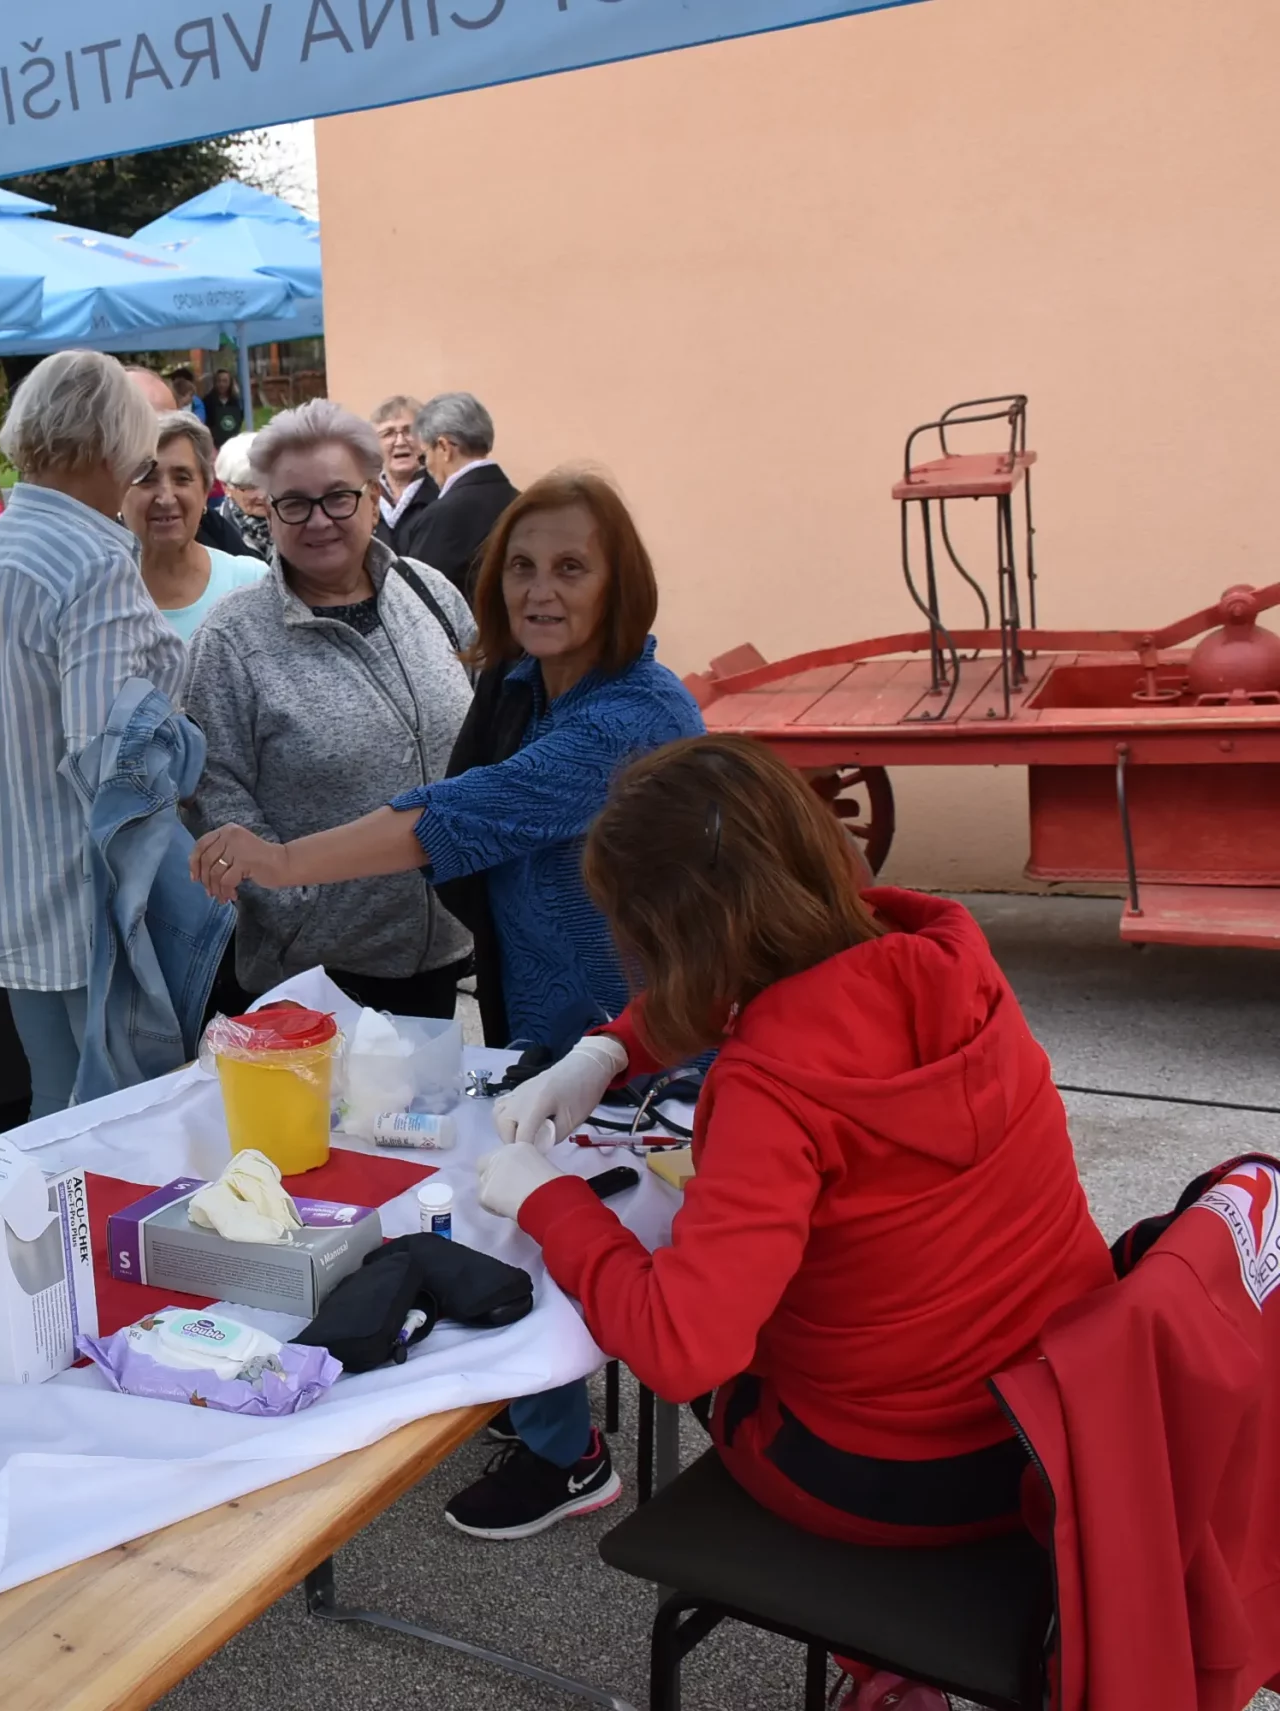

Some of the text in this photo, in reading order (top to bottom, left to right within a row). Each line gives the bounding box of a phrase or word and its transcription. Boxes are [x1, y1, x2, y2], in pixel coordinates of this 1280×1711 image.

[73, 1176, 89, 1263] ACCU-CHEK
[119, 1250, 131, 1269] S
[183, 1323, 225, 1340] double
